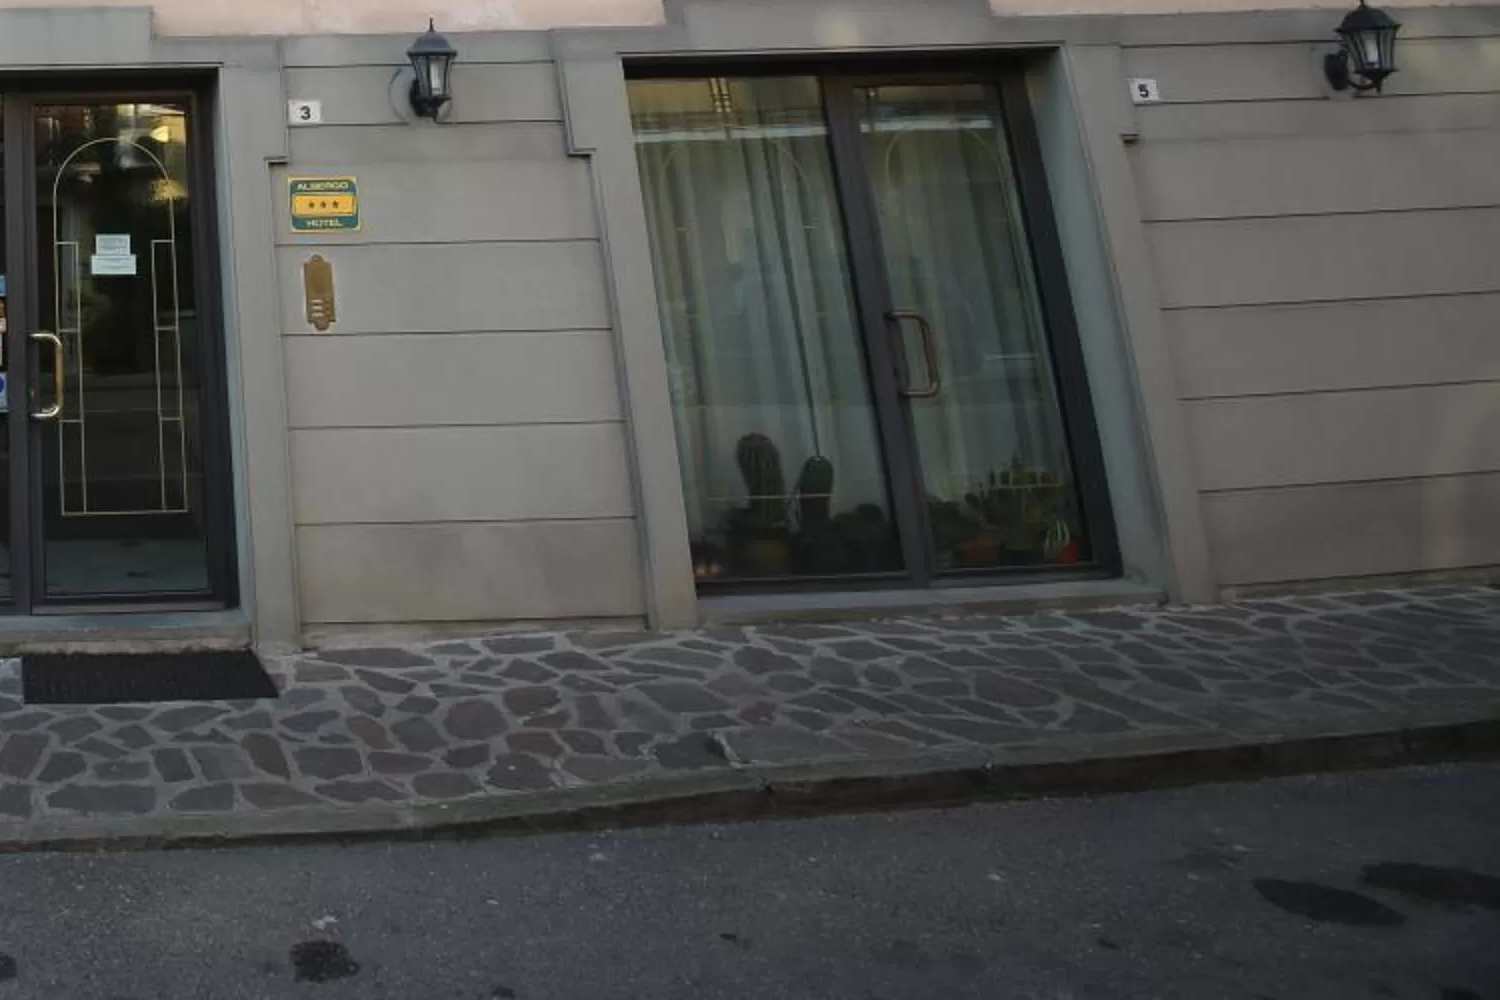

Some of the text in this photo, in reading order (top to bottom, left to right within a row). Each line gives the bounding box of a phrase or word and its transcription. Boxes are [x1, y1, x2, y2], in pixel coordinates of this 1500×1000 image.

[1137, 83, 1149, 99] 5
[300, 105, 311, 121] 3
[306, 218, 344, 228] HOTEL
